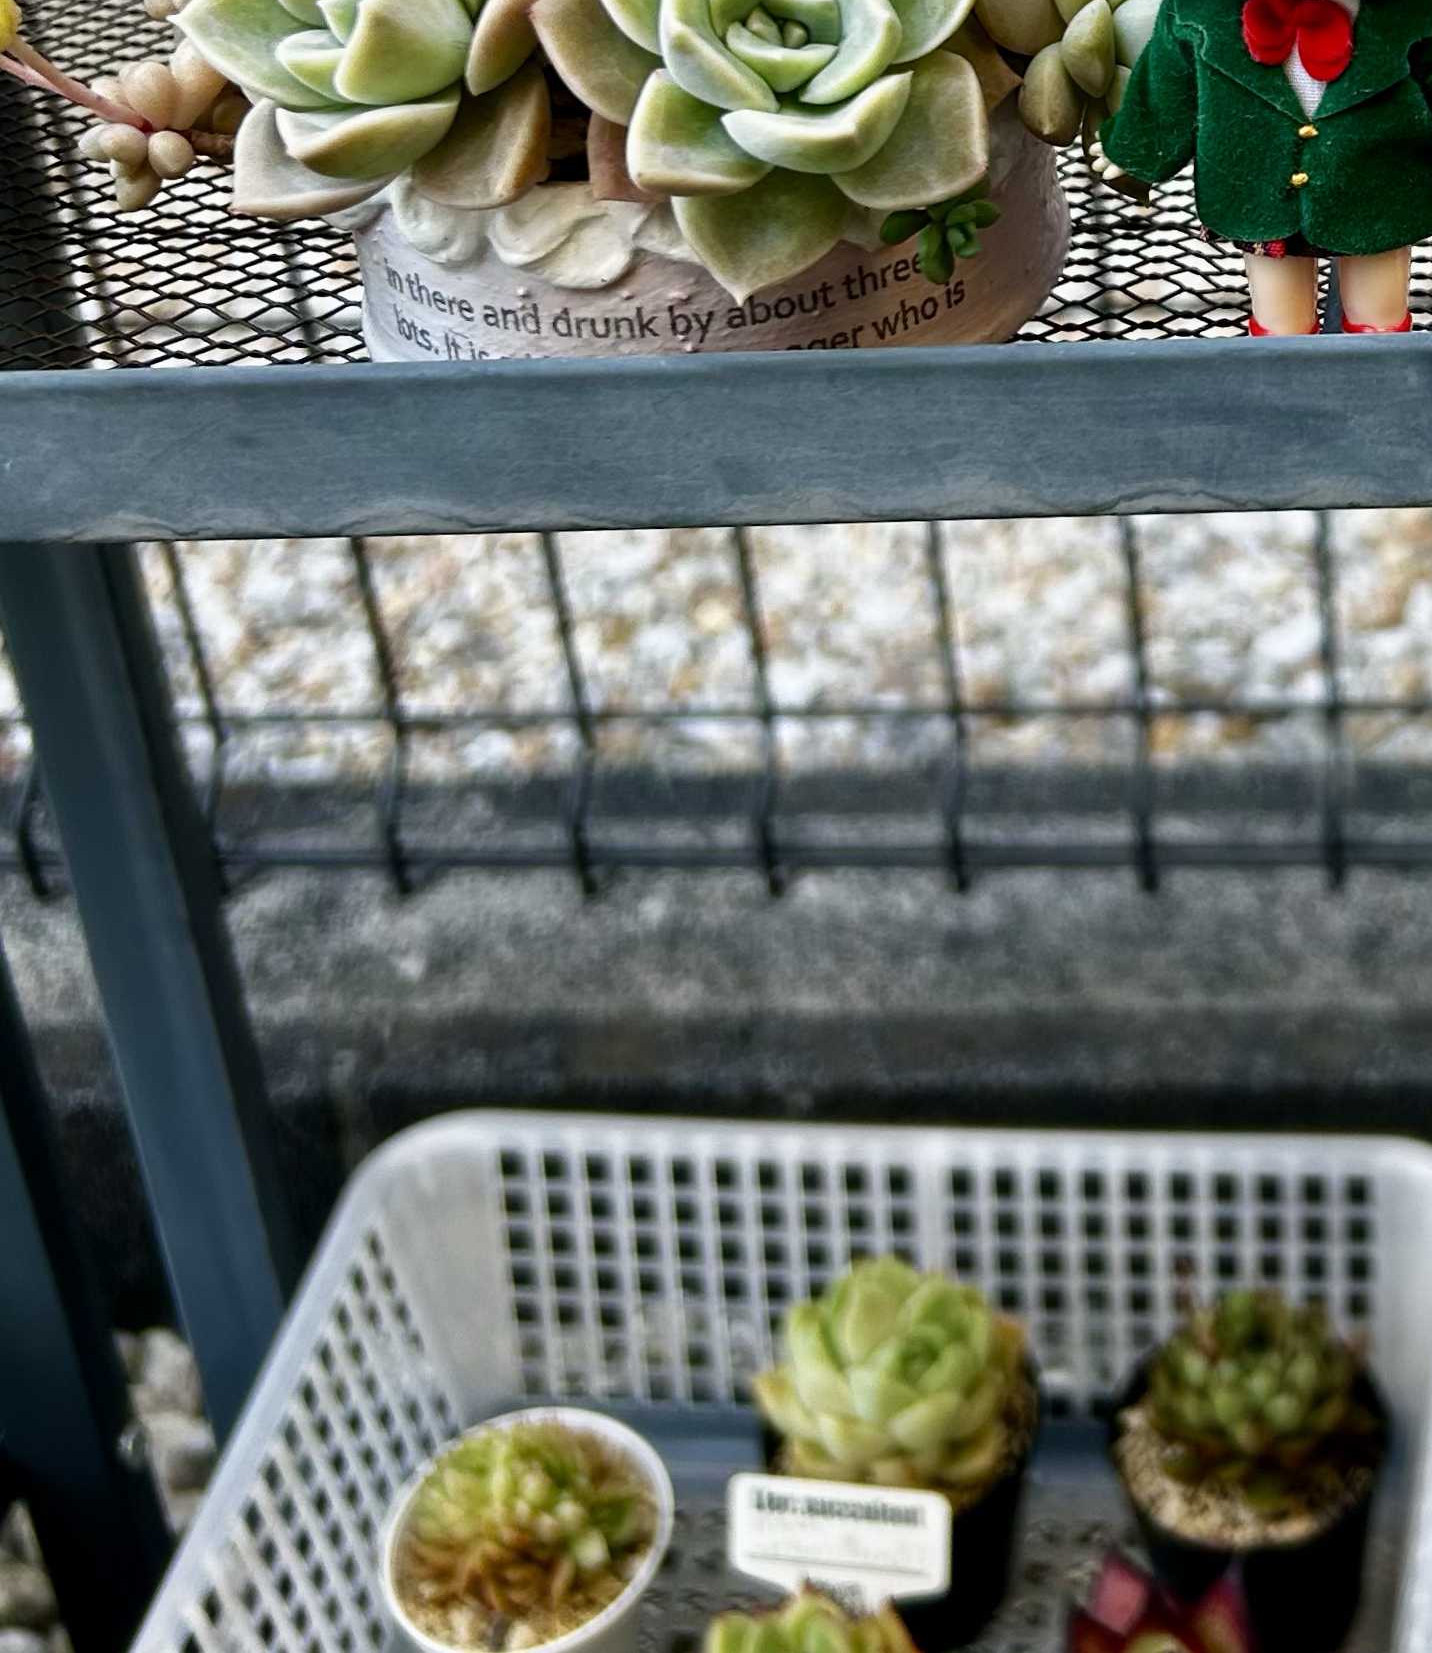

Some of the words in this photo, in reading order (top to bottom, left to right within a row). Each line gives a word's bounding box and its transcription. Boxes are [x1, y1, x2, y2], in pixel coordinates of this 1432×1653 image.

[384, 257, 405, 294] in
[406, 273, 475, 322] there
[483, 302, 541, 336] and
[552, 307, 659, 338] drunk
[668, 304, 715, 345] by
[726, 280, 836, 329] about
[393, 303, 440, 355] lots.
[871, 296, 939, 341] who
[945, 279, 966, 310] is
